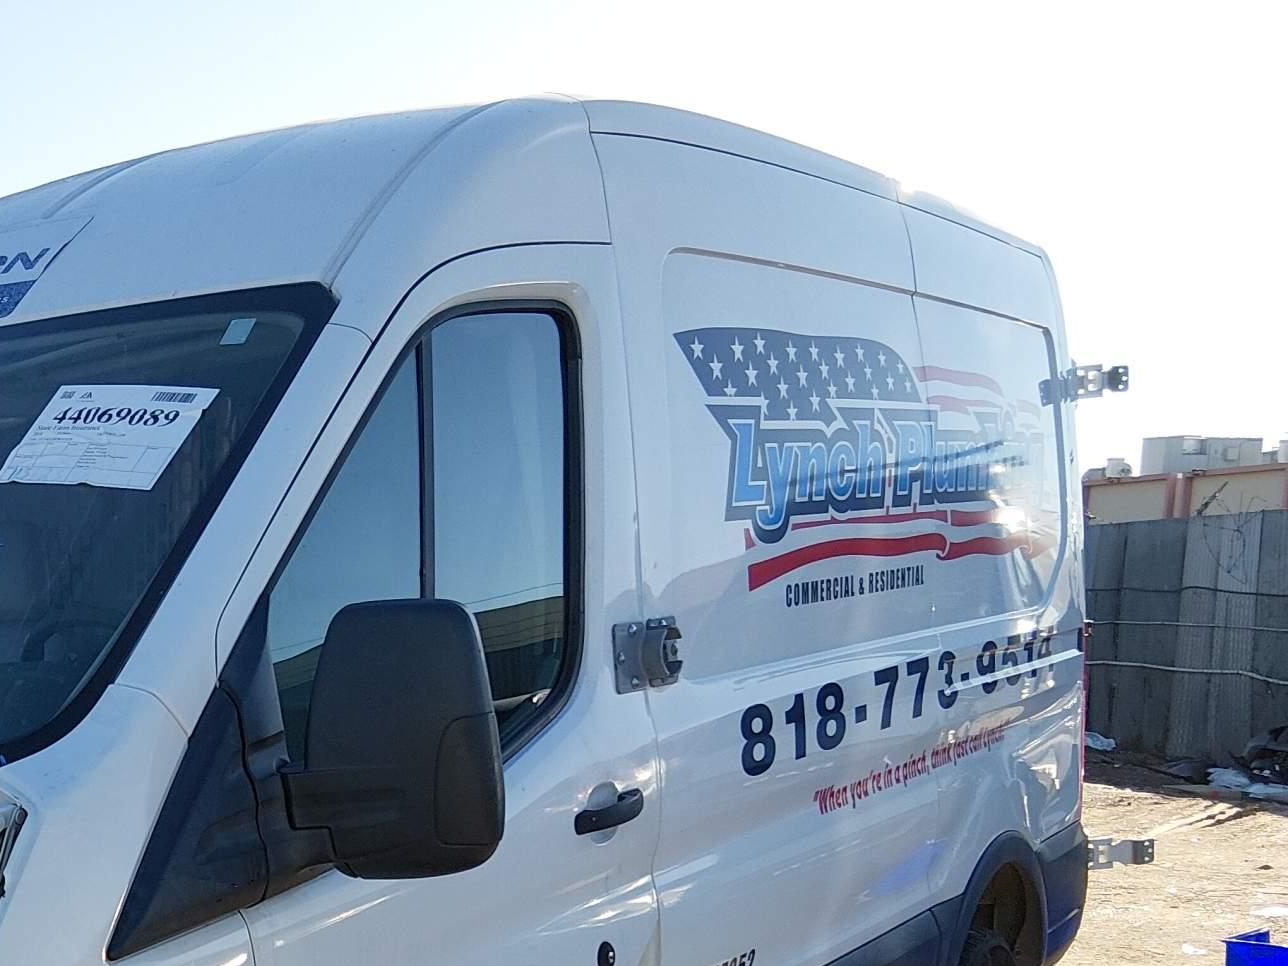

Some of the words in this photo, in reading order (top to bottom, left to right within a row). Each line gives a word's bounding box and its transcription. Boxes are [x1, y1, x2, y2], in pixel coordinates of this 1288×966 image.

[52, 406, 181, 427] 44069089
[730, 419, 885, 529] Lynch
[892, 418, 1045, 502] Plum
[785, 574, 855, 608] COMMERCIAL
[858, 577, 865, 595] &
[868, 564, 925, 594] RESIDENTIAL
[850, 769, 883, 809] you're
[883, 762, 893, 789] in
[894, 769, 901, 785] a
[902, 751, 930, 787] pinch,
